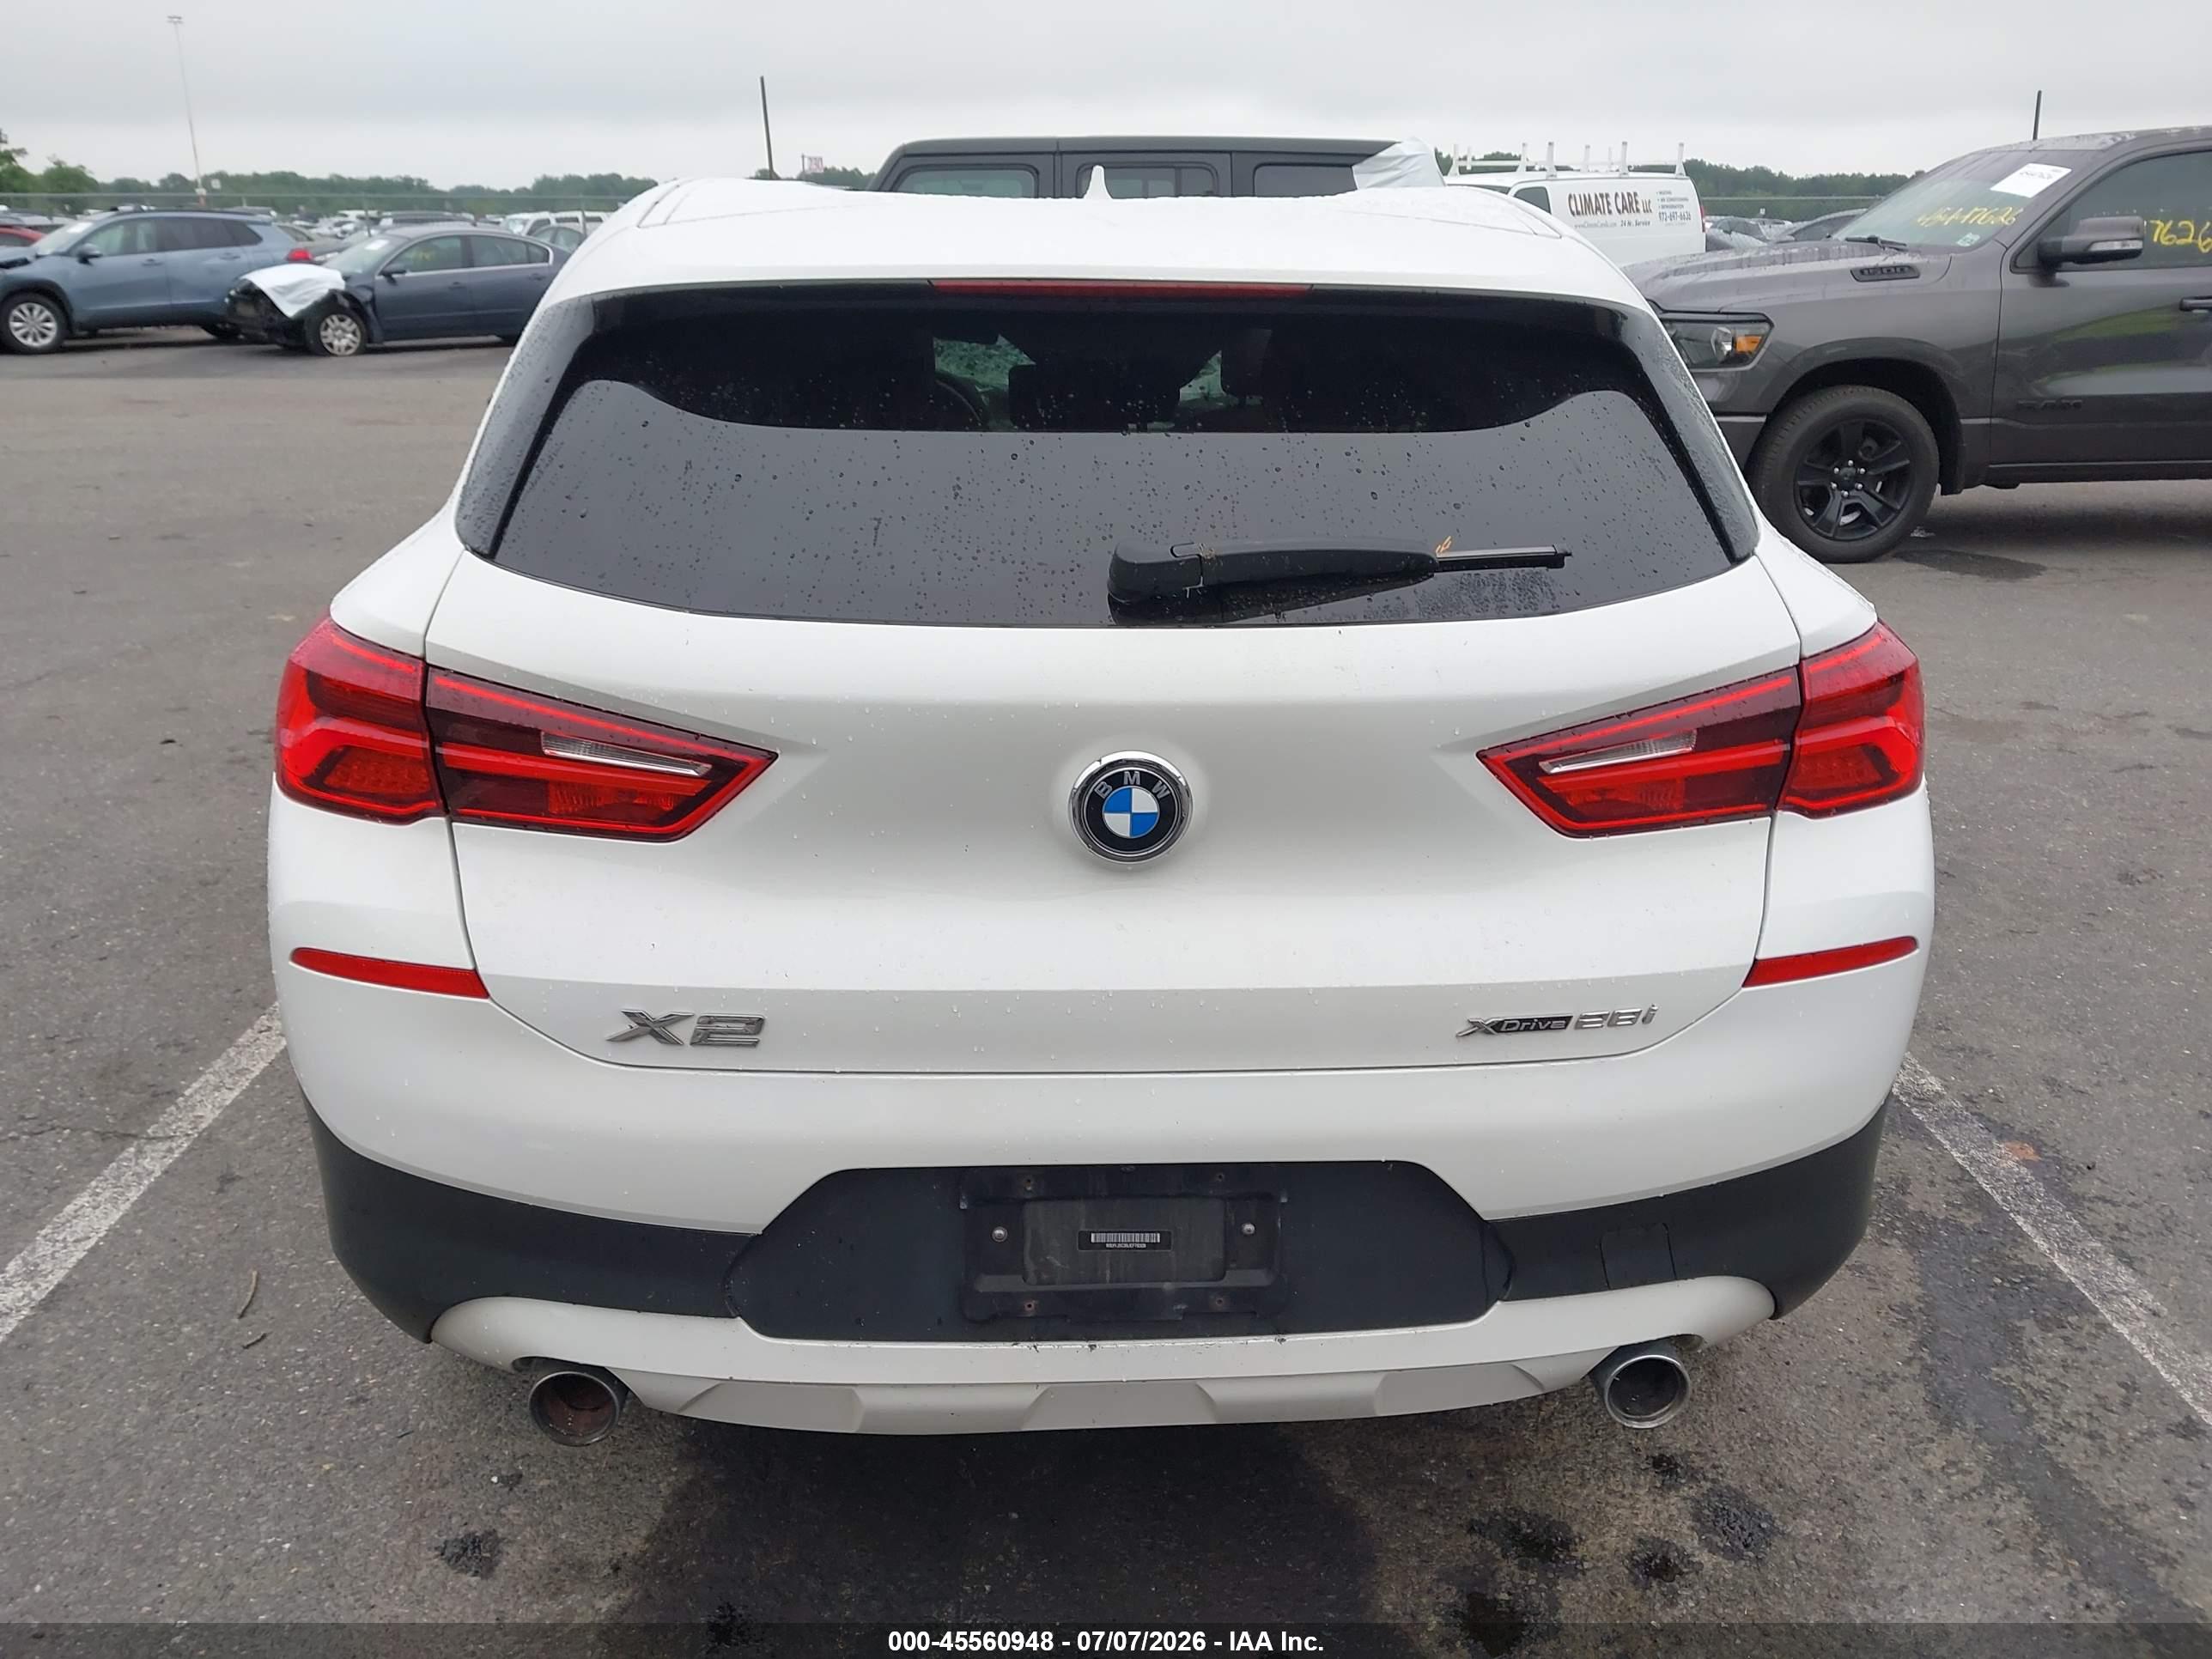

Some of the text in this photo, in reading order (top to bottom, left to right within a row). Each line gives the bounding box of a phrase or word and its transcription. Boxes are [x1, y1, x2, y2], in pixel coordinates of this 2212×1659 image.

[1568, 191, 1653, 217] CLIMATE CARE LLC
[1094, 770, 1171, 799] BMW
[605, 1009, 766, 1048] X2
